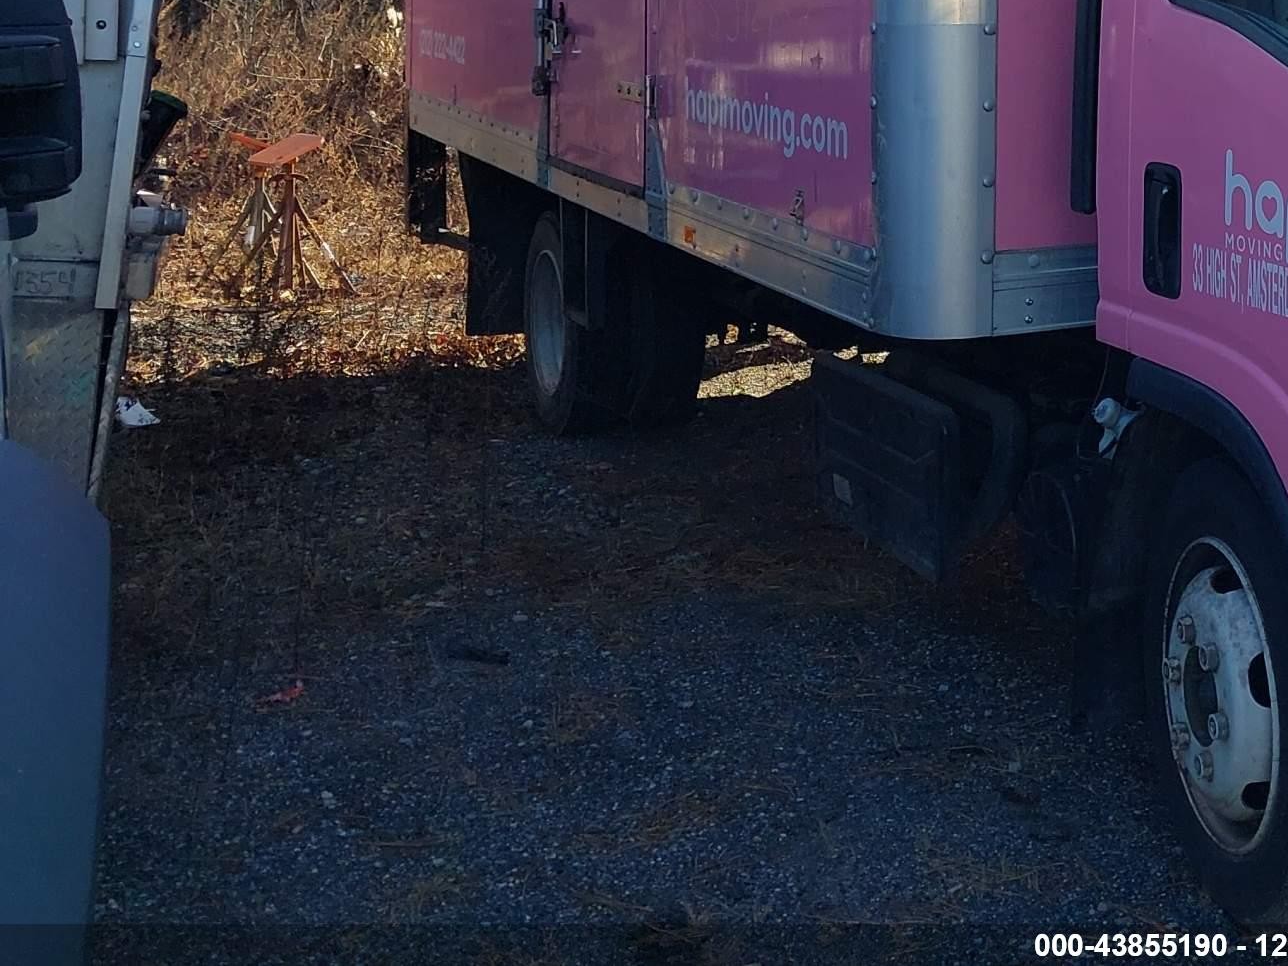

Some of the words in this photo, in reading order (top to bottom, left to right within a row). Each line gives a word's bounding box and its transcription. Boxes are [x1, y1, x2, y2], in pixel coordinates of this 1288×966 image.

[685, 82, 849, 160] hapimoving.com
[1192, 242, 1203, 293] 33
[1206, 245, 1227, 299] HIGH
[1225, 232, 1283, 261] MOVING
